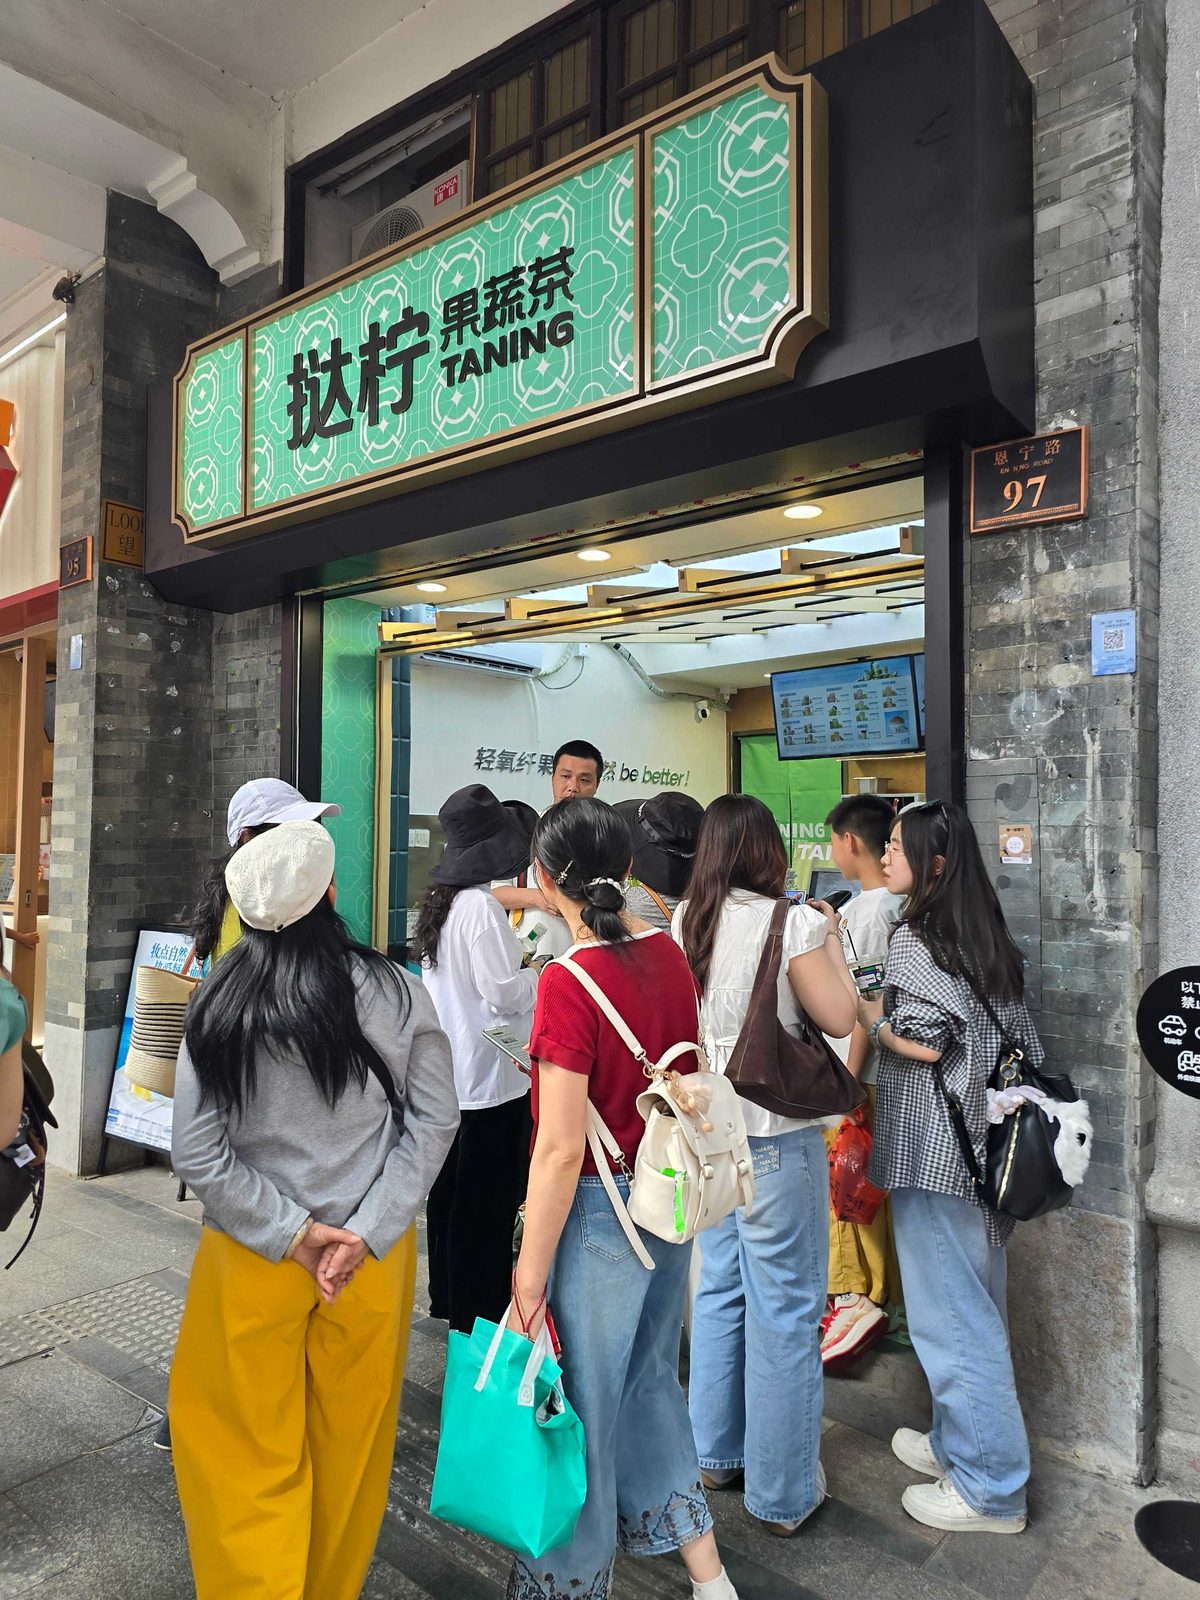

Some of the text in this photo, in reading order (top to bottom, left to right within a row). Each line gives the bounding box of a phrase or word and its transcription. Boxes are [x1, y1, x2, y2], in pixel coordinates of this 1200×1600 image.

[434, 177, 458, 194] KONKA
[440, 246, 575, 351] 果蔬茶
[440, 311, 574, 387] TANING
[287, 305, 430, 450] 挞柠
[994, 439, 1061, 466] 恩宁路
[1033, 458, 1053, 468] ROAD
[1003, 474, 1047, 512] 97
[67, 557, 80, 578] 95
[619, 762, 690, 787] be better!
